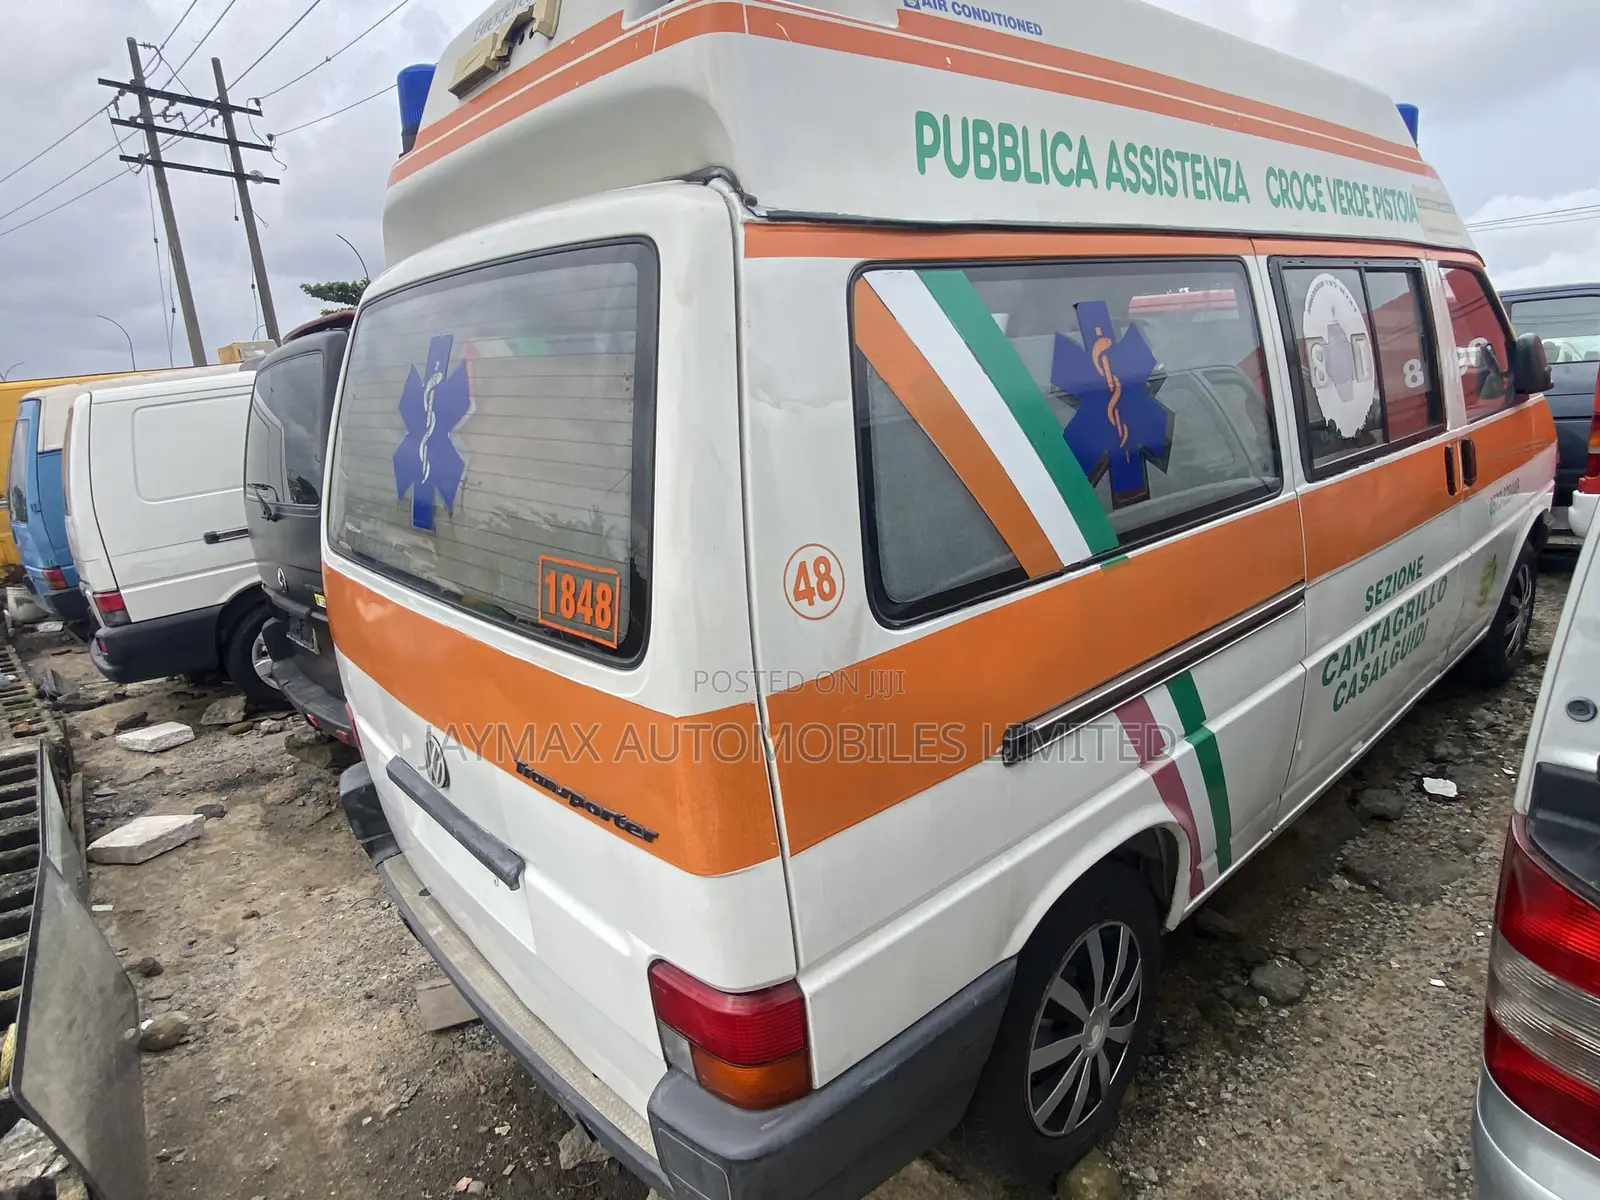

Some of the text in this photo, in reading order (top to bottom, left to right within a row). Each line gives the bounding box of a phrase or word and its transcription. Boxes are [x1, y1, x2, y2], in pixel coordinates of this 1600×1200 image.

[951, 2, 1043, 36] CONDITIONED
[915, 110, 1419, 224] PUBBLICA ASSISTENZA CROCE VERDE PISTOIA
[545, 569, 612, 630] 1848
[793, 555, 836, 607] 48
[1364, 554, 1424, 612] SEZIONE
[1321, 575, 1448, 686] CANTAGRILLO
[1332, 617, 1430, 712] CASALGUIDI
